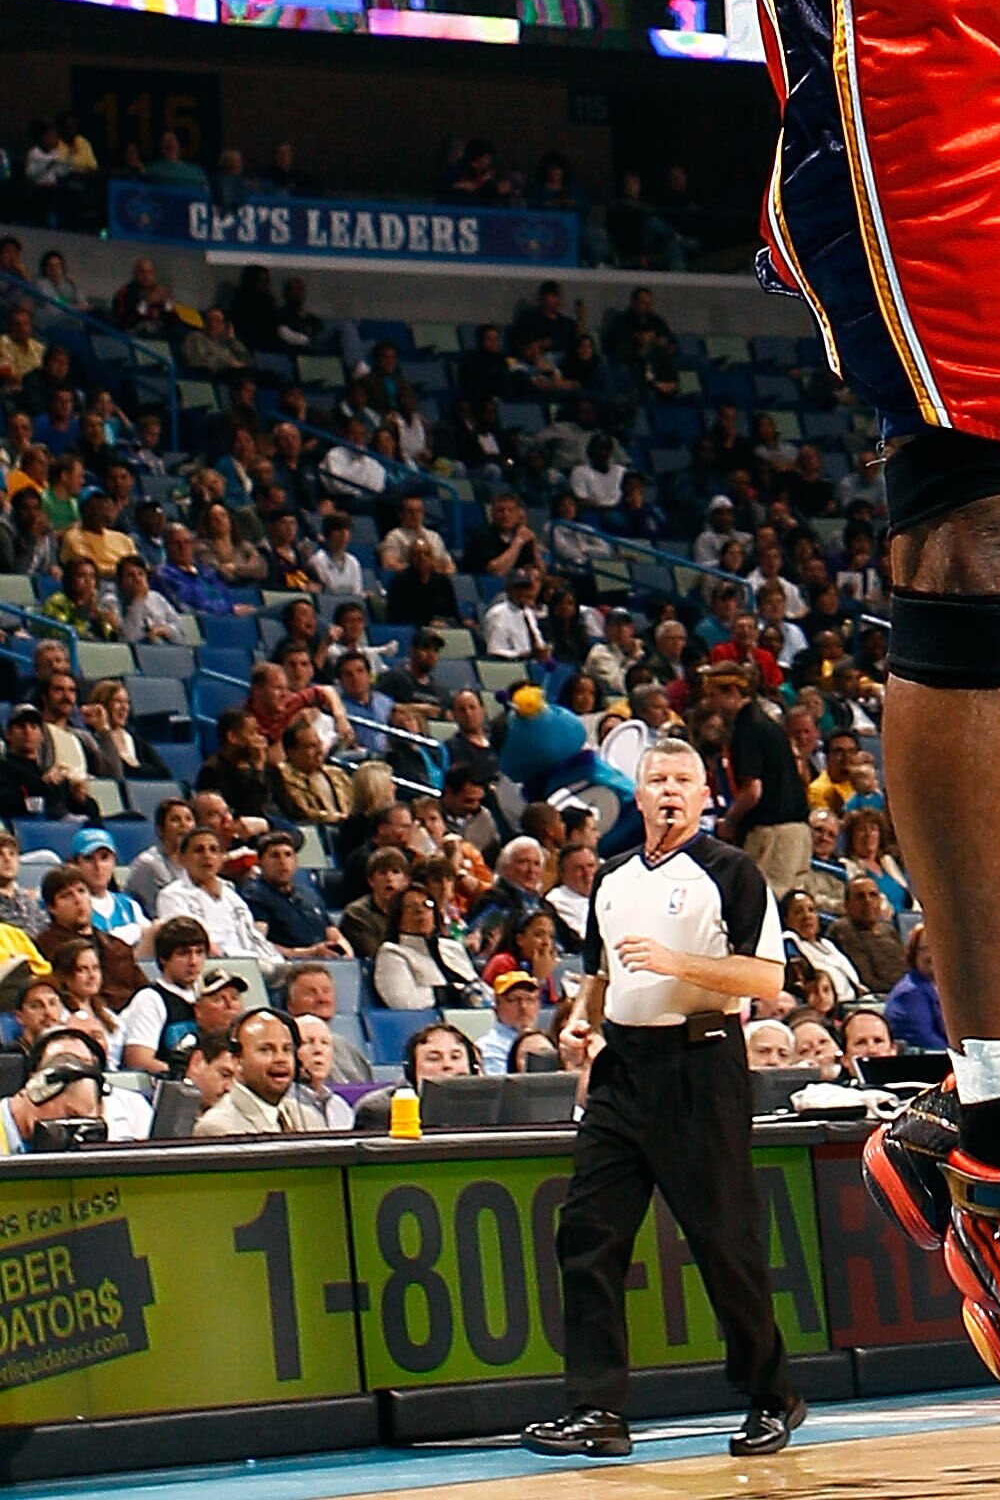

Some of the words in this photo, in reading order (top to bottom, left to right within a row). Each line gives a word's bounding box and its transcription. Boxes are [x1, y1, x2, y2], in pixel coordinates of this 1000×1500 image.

[92, 89, 200, 163] 115
[306, 208, 479, 254] LEADERS
[0, 1245, 76, 1302] BER
